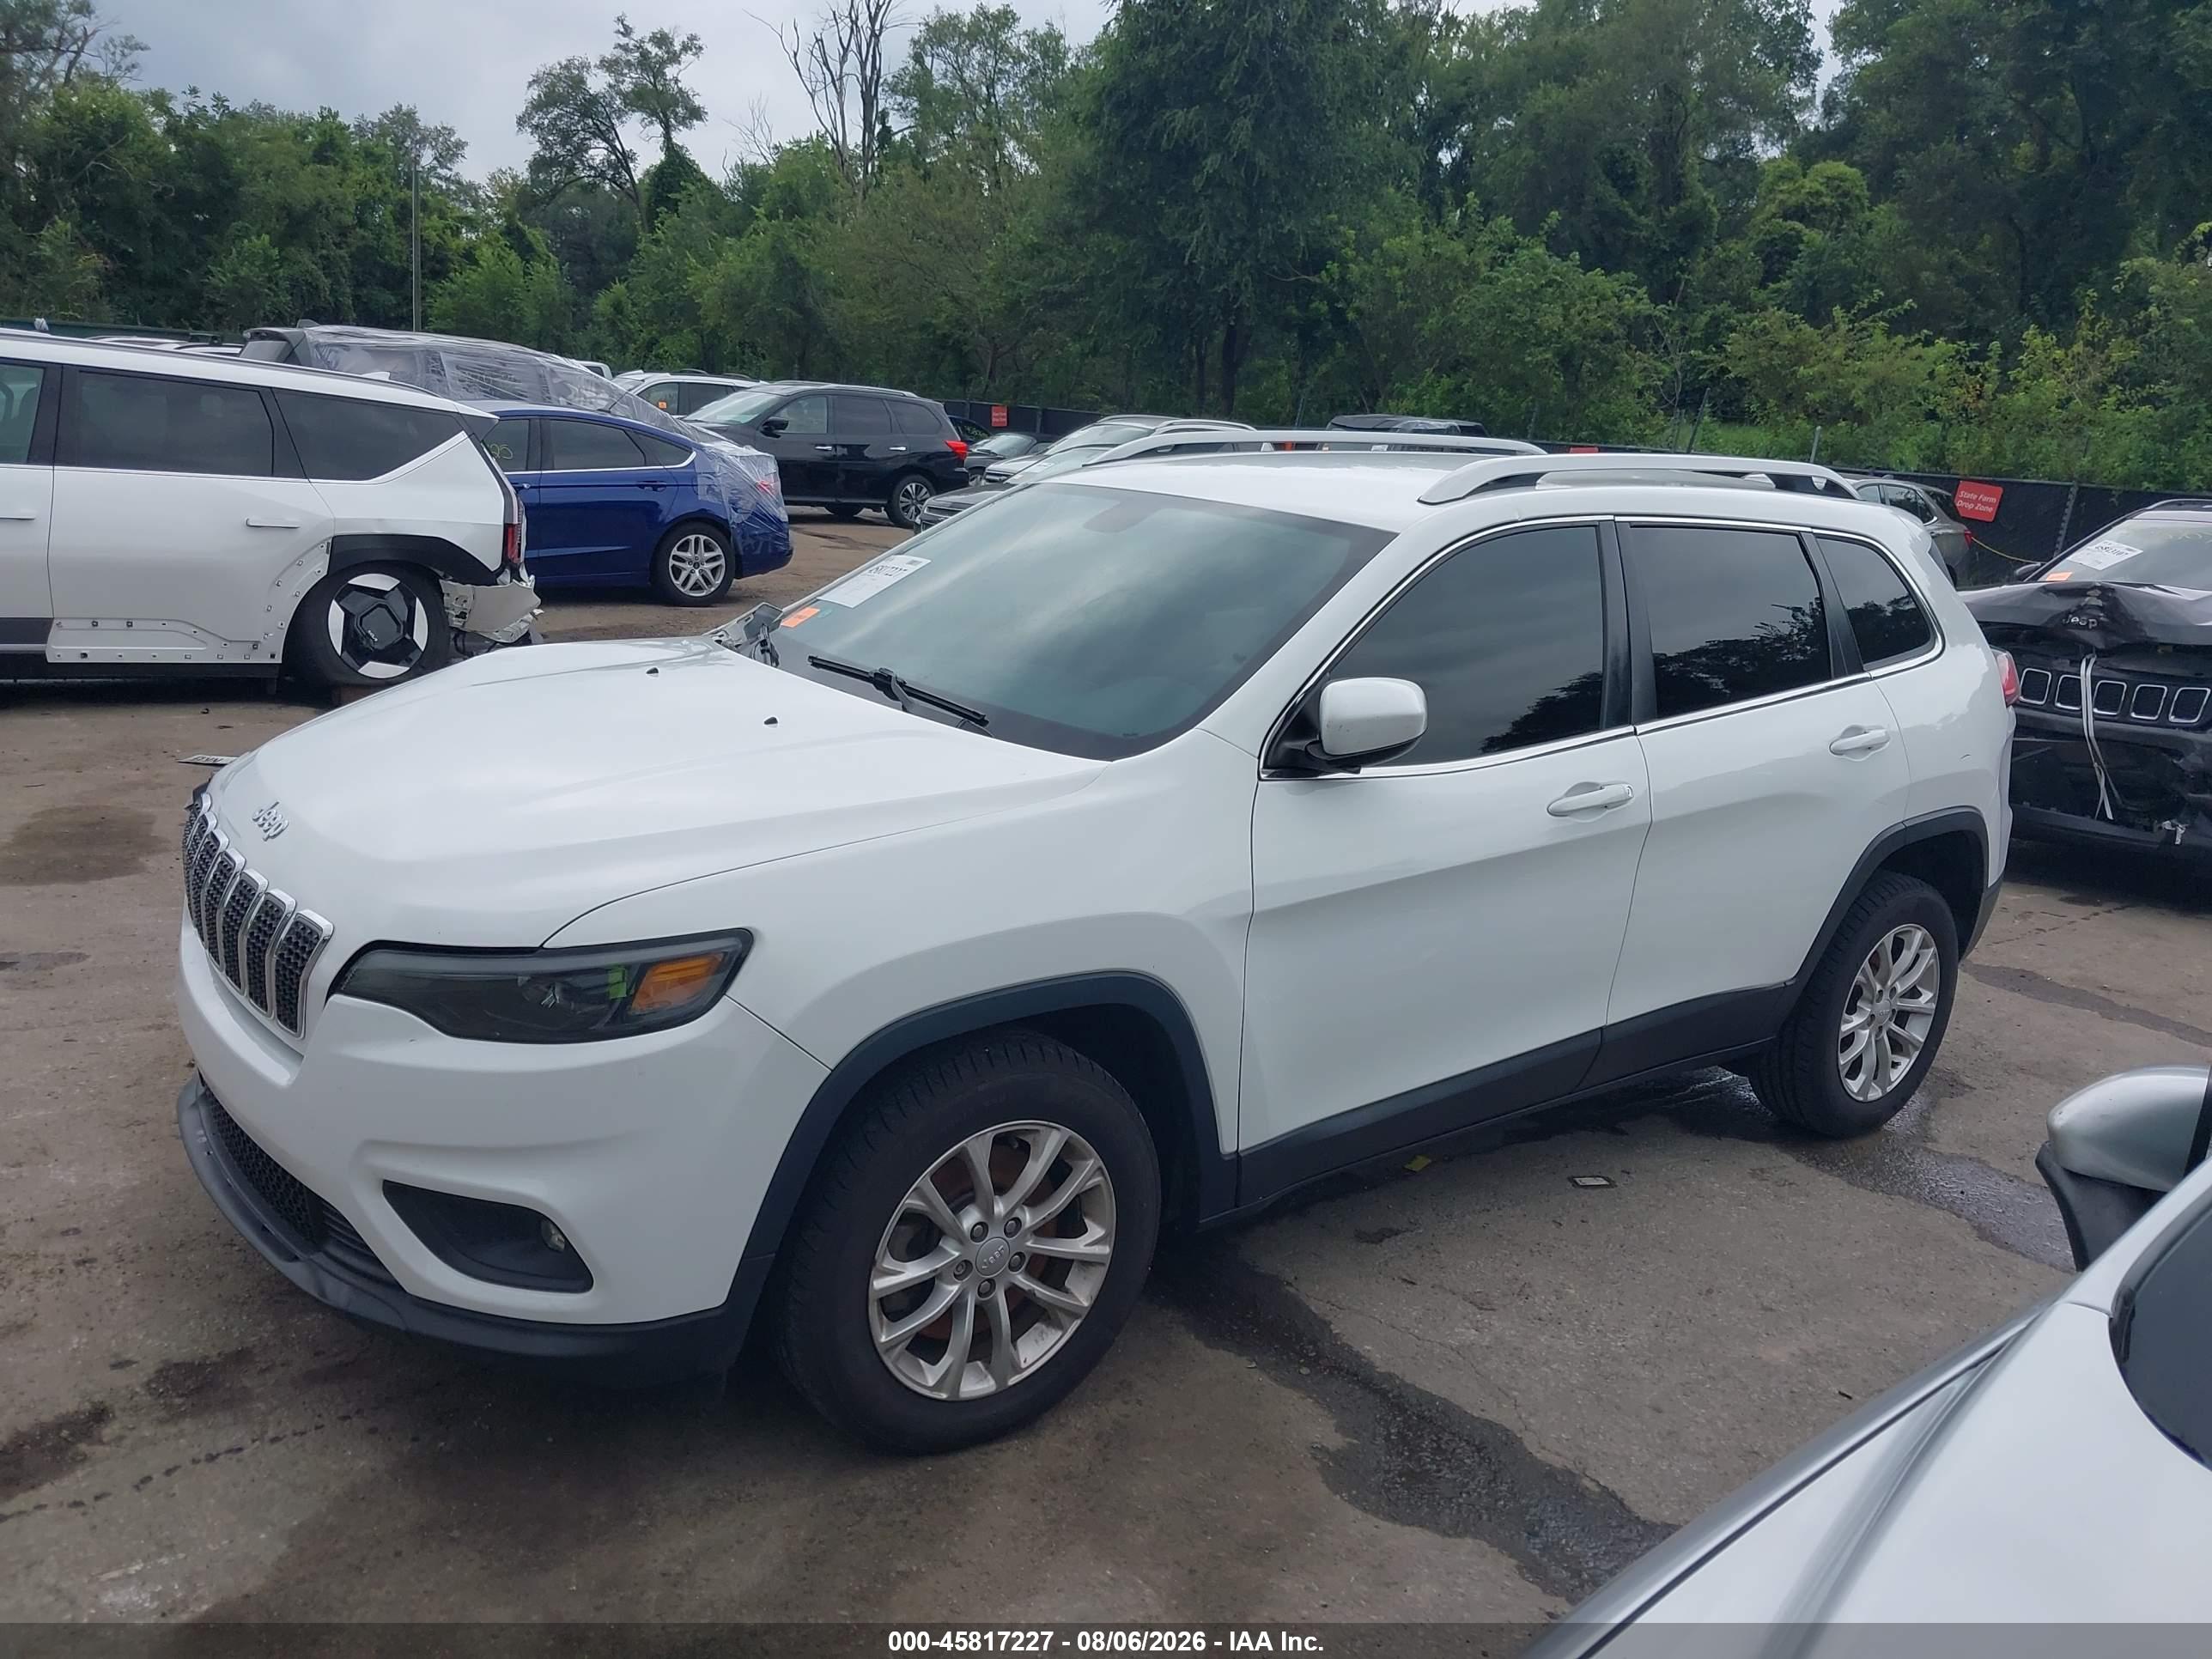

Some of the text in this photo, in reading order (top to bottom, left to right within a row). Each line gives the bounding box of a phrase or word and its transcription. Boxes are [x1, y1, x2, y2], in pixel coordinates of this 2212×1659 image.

[1959, 490, 1996, 503] State Farm
[1956, 500, 1993, 513] Drop Zone
[2063, 614, 2098, 629] Jeep
[252, 801, 289, 842] Jeep
